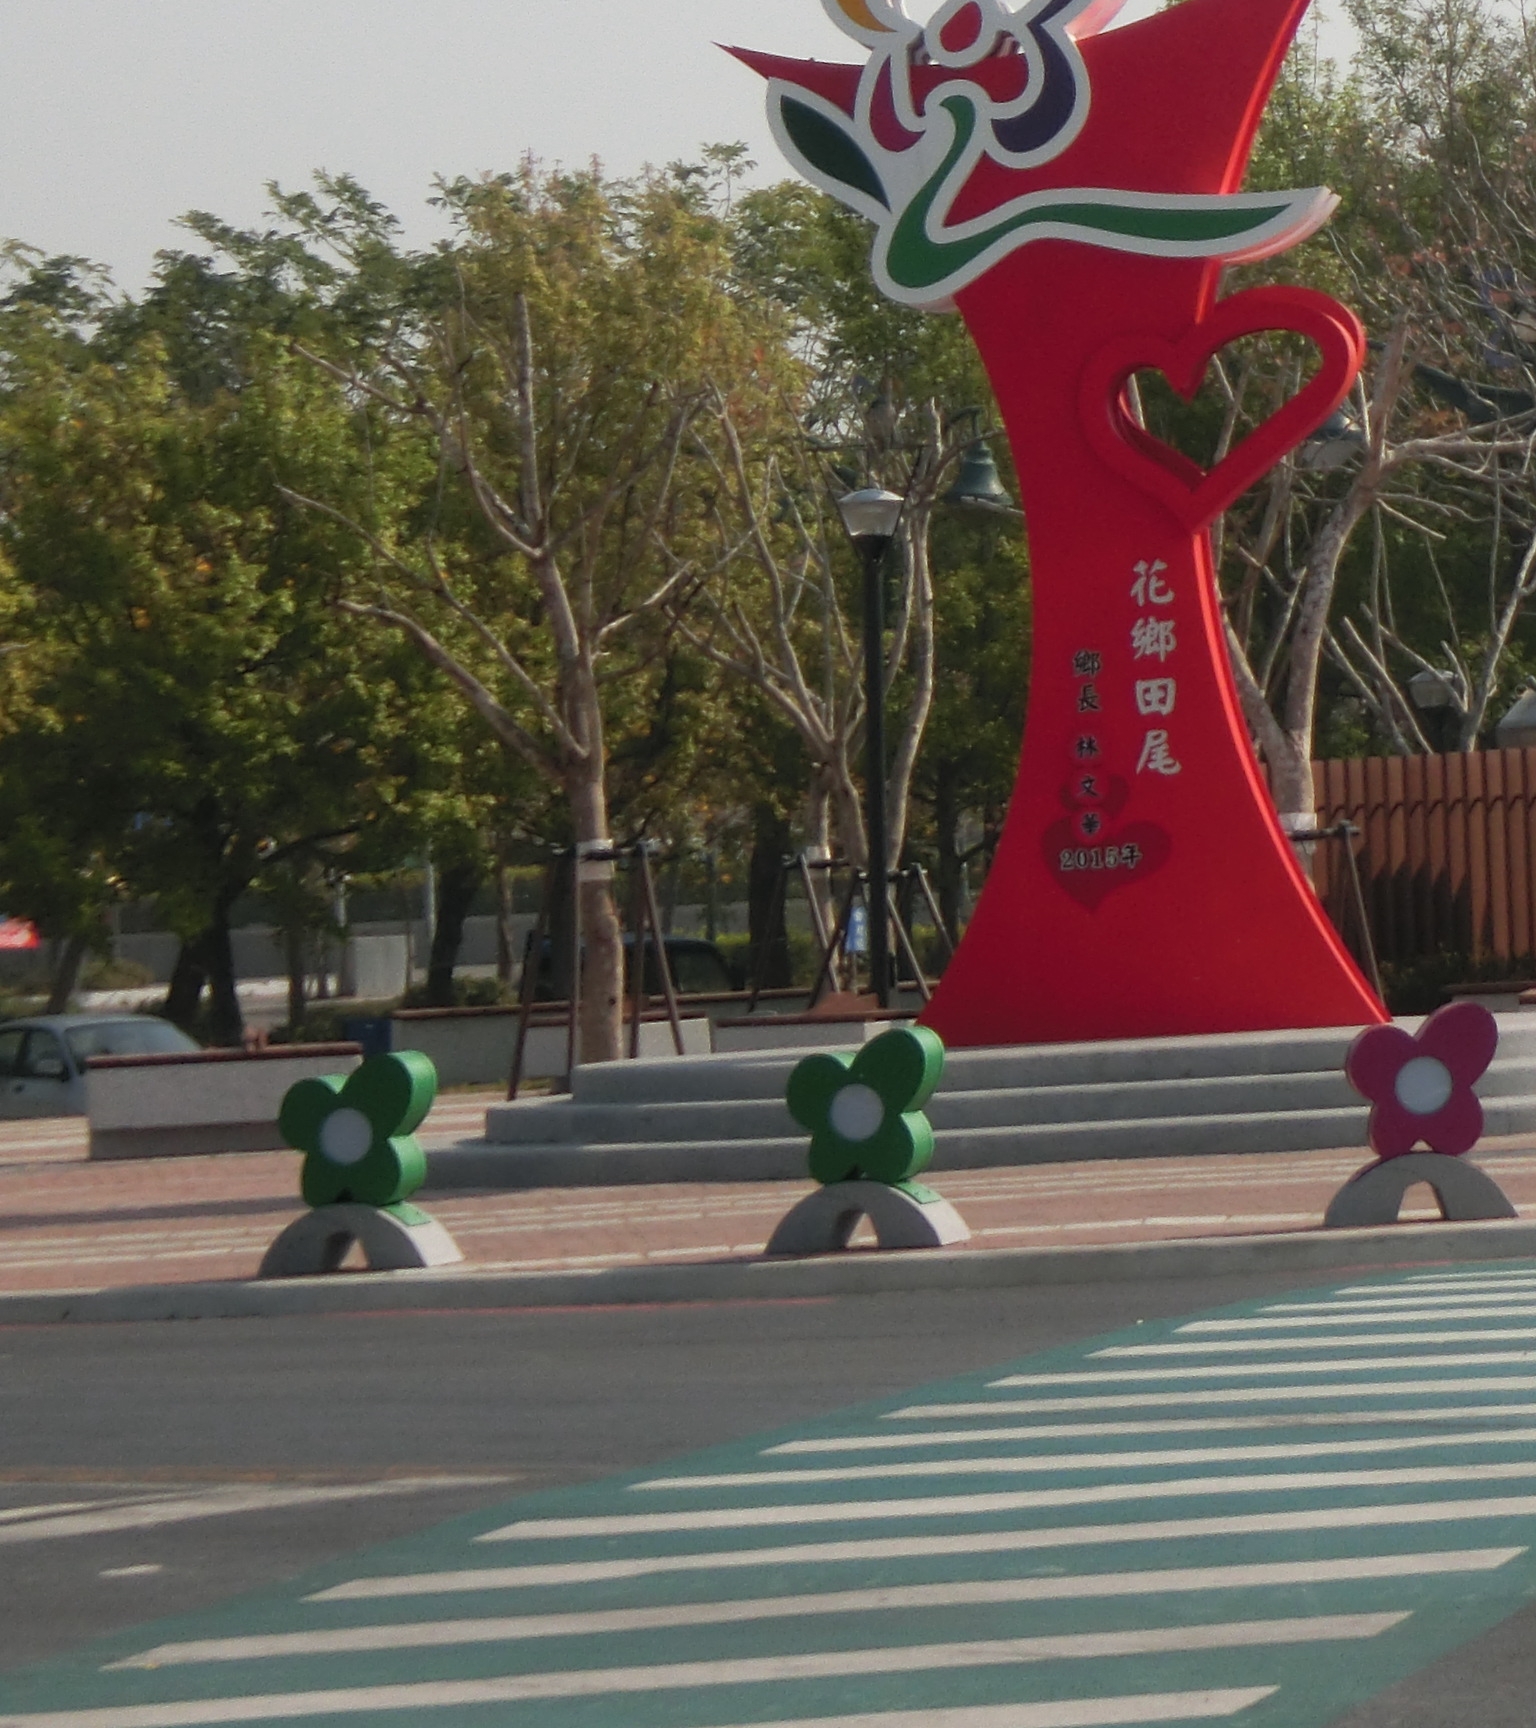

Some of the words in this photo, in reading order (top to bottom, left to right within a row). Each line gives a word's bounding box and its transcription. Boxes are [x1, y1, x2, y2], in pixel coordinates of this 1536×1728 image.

[1130, 557, 1182, 776] 花鄉田尾
[1059, 844, 1142, 871] 2015年
